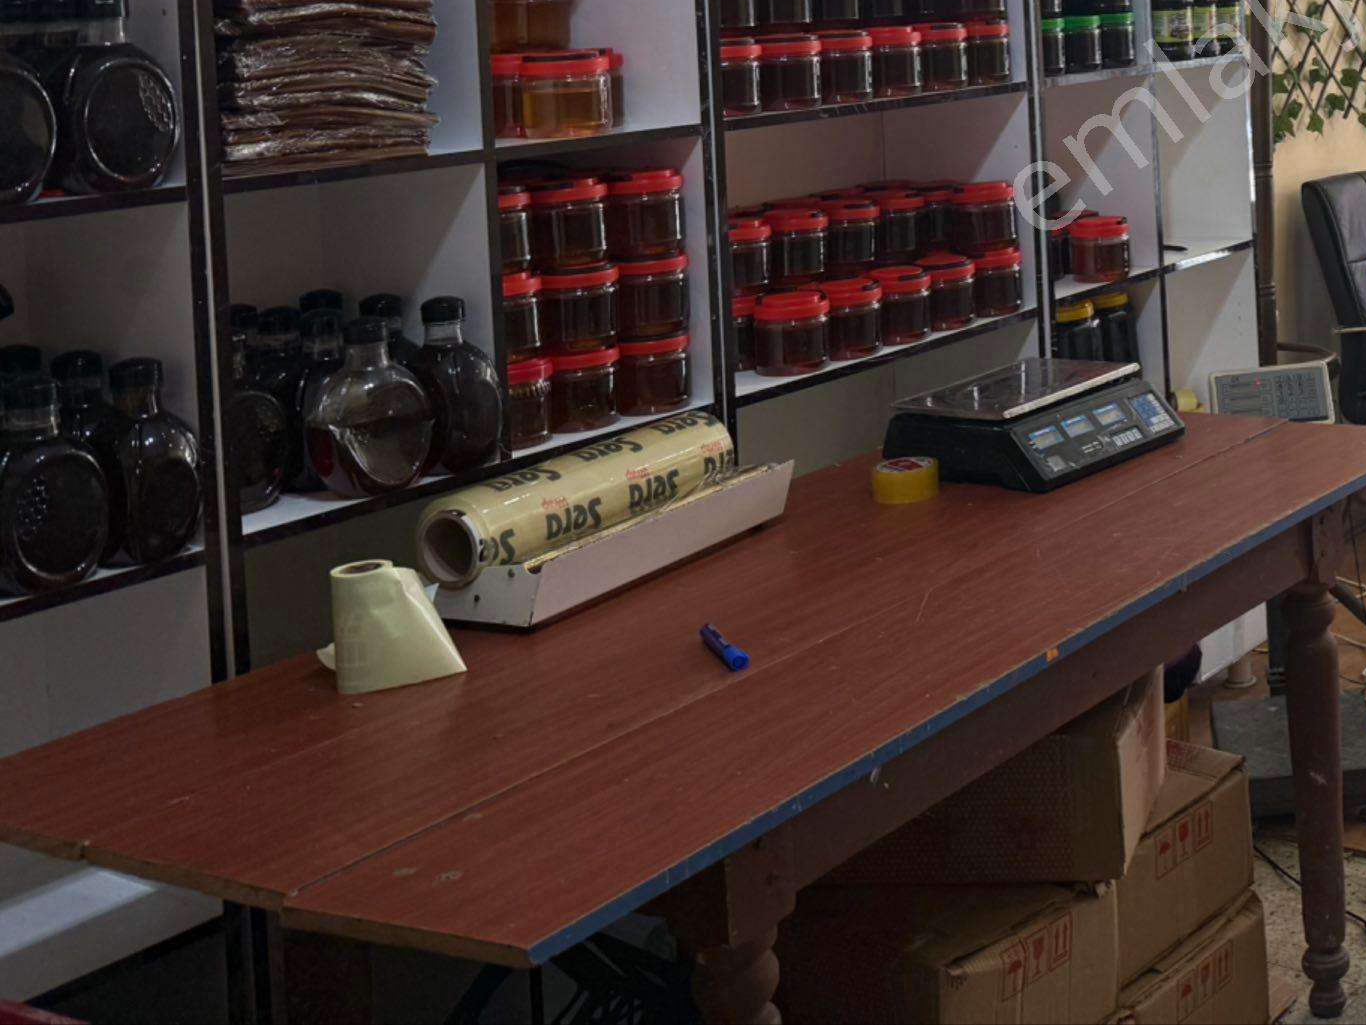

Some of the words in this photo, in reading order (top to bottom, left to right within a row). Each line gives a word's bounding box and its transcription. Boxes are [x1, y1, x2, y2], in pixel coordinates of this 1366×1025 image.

[575, 436, 643, 462] Sera
[628, 468, 680, 510] Sera
[544, 497, 603, 541] Sera
